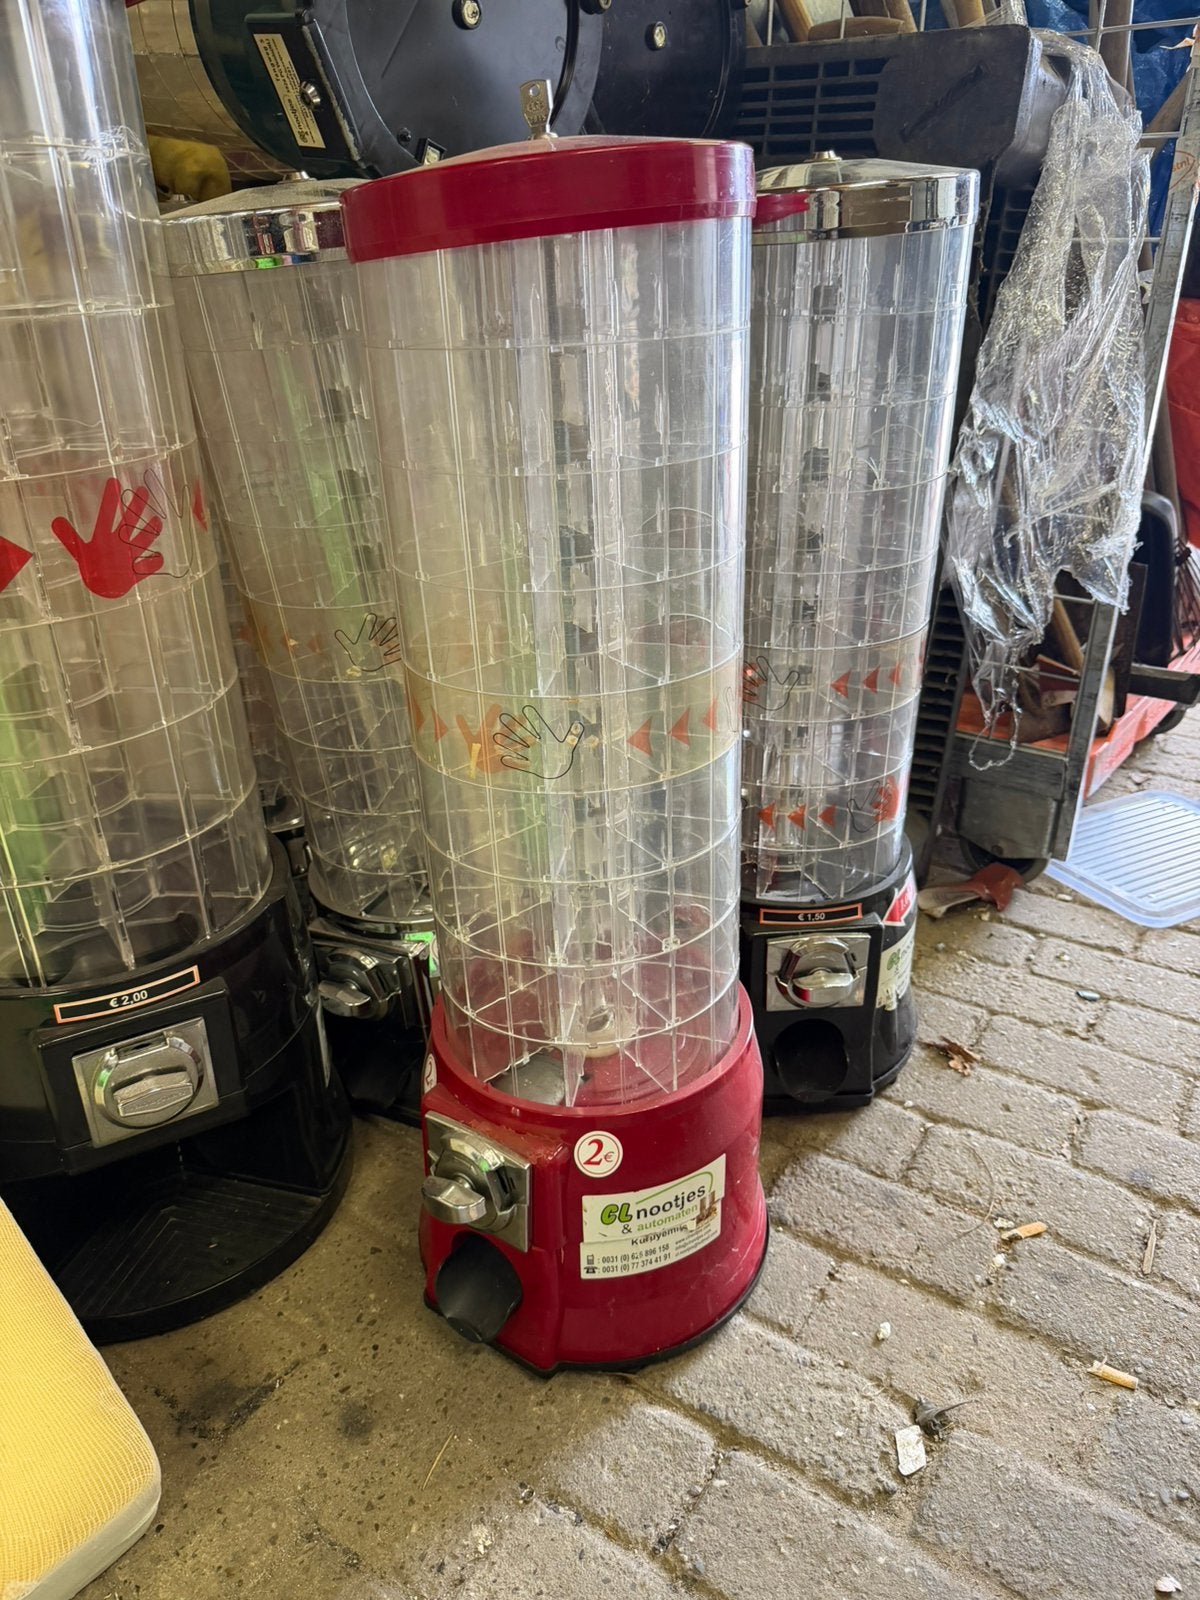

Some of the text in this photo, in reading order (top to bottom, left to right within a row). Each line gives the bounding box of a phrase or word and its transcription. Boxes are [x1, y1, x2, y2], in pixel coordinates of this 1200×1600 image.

[109, 990, 148, 1008] € 2,00
[636, 1184, 706, 1220] nootjes
[621, 1203, 699, 1235] & automaten
[601, 1255, 618, 1264] 0031
[620, 1253, 630, 1263] (0)
[601, 1265, 618, 1273] 0031
[620, 1263, 630, 1273] (0)
[631, 1261, 640, 1270] 77
[641, 1258, 653, 1267] 374
[654, 1255, 662, 1263] 41
[663, 1252, 671, 1261] 91
